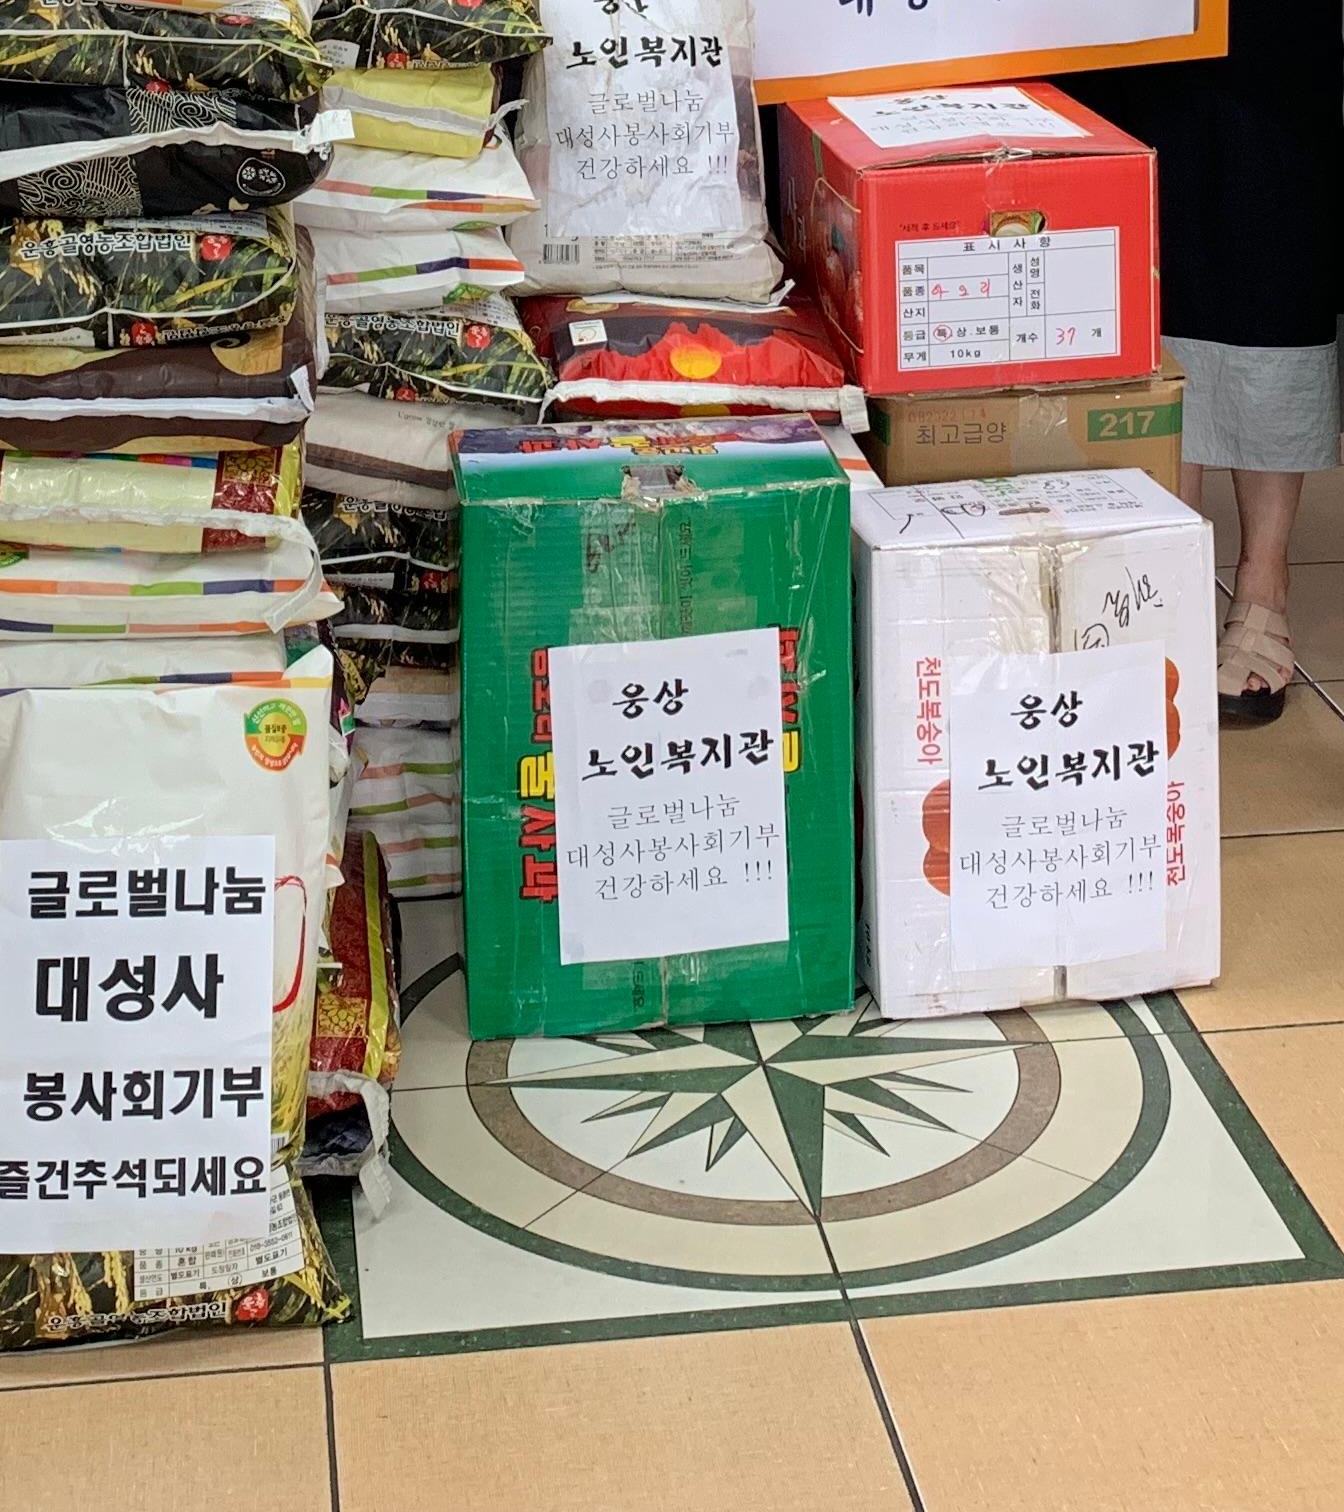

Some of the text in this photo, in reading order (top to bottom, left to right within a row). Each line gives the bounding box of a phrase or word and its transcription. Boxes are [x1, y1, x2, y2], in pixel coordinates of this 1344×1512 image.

[565, 35, 724, 71] 노인복지관
[587, 89, 705, 115] 글로벌나눔
[555, 121, 737, 150] 대성사봉사회기부
[575, 153, 695, 182] 건강하세요
[902, 306, 926, 319] 산지
[903, 350, 927, 363] 무게
[915, 422, 1007, 446] 최고급양
[1097, 410, 1155, 437] 217
[611, 678, 690, 718] 웅상
[915, 656, 950, 766] 천도복숭아
[1010, 690, 1084, 728] 웅상
[580, 731, 775, 783] 노인복지관
[977, 741, 1160, 792] 노인복지관
[606, 794, 741, 831] 글로벌나눔
[1000, 805, 1128, 838] 글로벌나눔
[565, 822, 782, 870] 대성사봉사회기부
[958, 831, 1163, 878] 대성사봉사회기부
[27, 869, 267, 920] 글로벌나눔
[593, 864, 730, 902] 건강하세요
[985, 873, 1114, 910] 건강하세요
[34, 954, 226, 1023] 대성사
[22, 1067, 265, 1123] 봉사회기부
